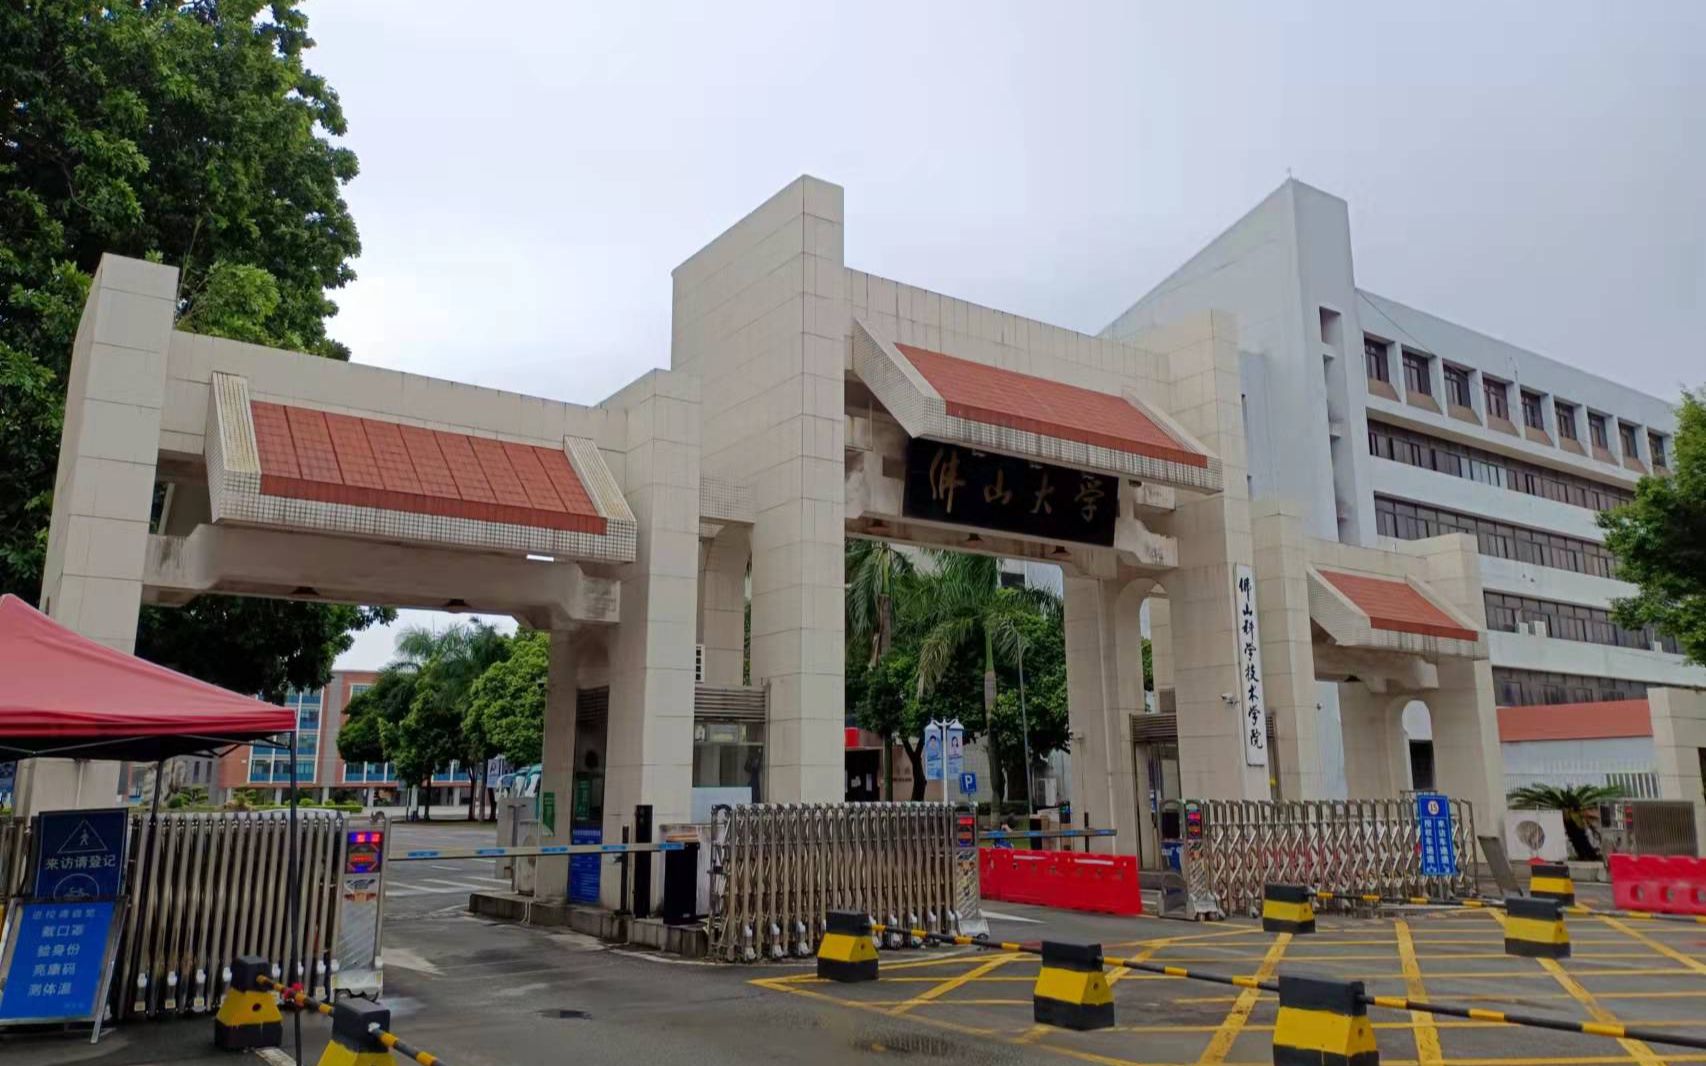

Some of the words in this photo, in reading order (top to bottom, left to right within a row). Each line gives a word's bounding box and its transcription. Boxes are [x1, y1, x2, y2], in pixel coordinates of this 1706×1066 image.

[929, 449, 1105, 522] 佛山大学
[1239, 577, 1263, 749] 佛山科学技术学院
[965, 775, 973, 789] P
[45, 855, 116, 870] 来访请登记
[41, 924, 85, 937] 戴口罩
[37, 943, 80, 957] 验身份
[28, 982, 72, 997] 测体温
